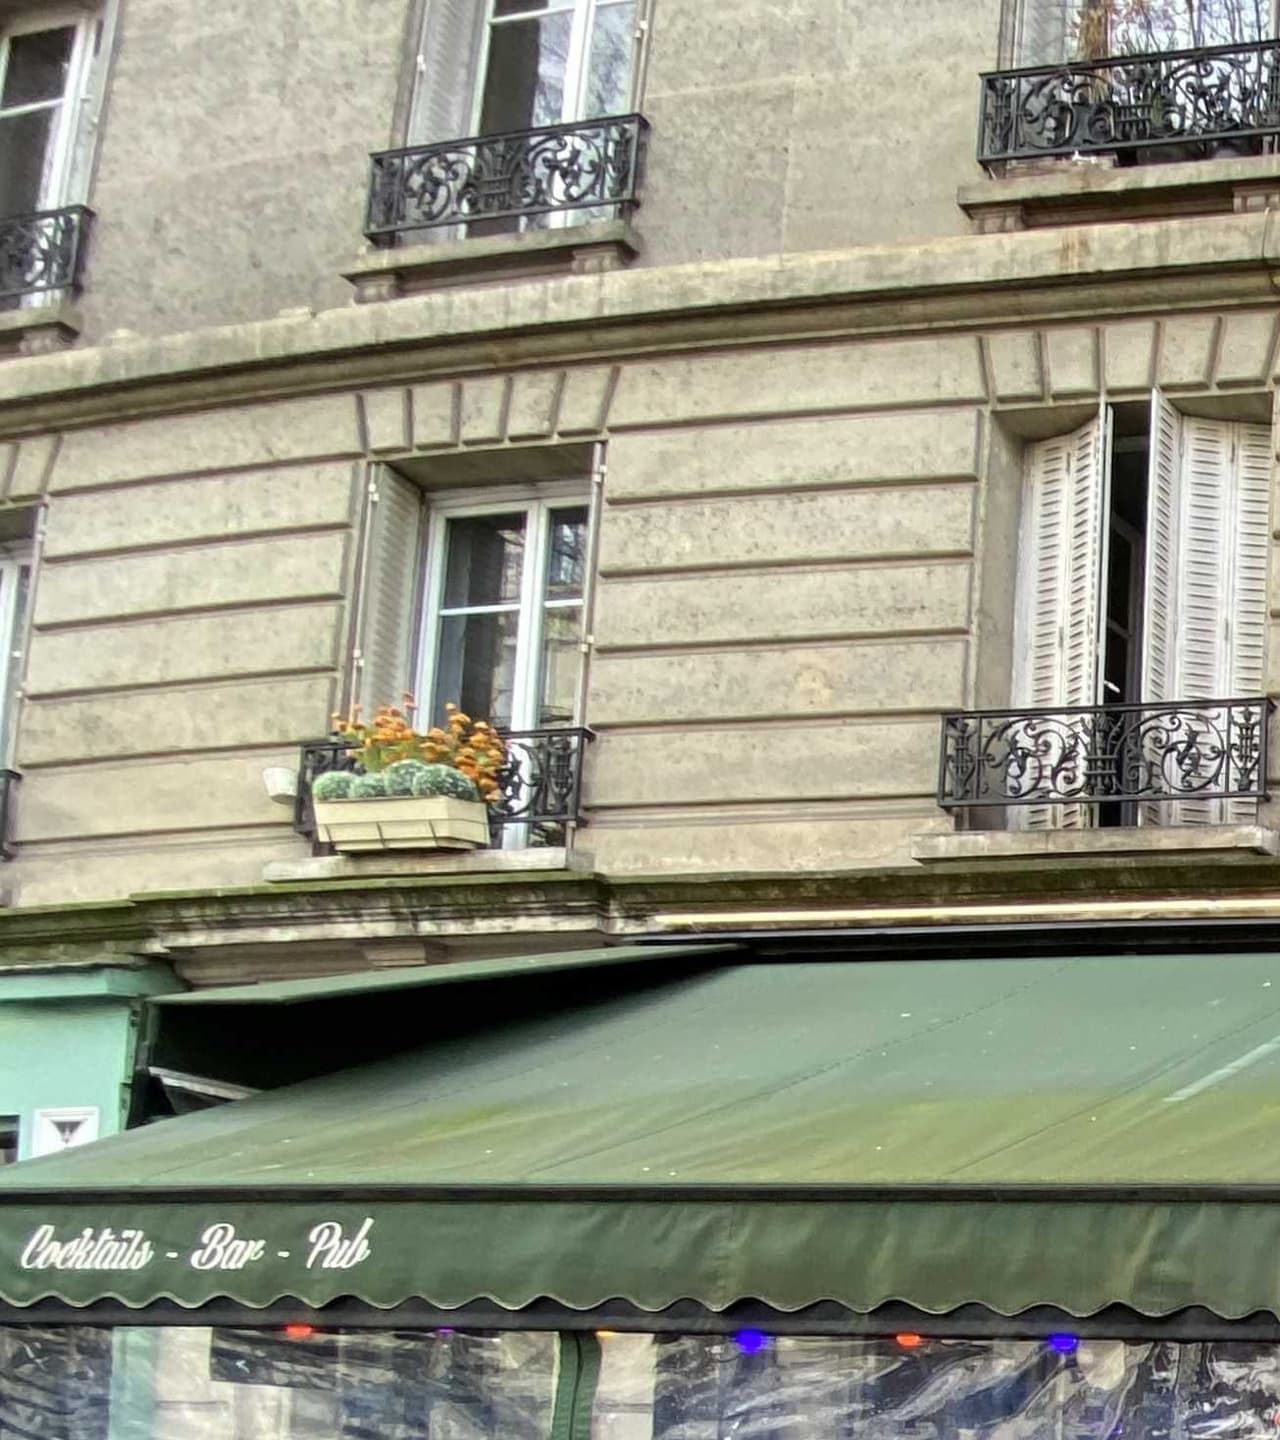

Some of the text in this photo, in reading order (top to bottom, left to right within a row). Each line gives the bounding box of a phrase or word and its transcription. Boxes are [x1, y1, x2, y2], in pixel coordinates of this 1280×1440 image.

[20, 1224, 153, 1271] Cocktails
[190, 1222, 267, 1272] Bar
[306, 1216, 375, 1270] Pub
